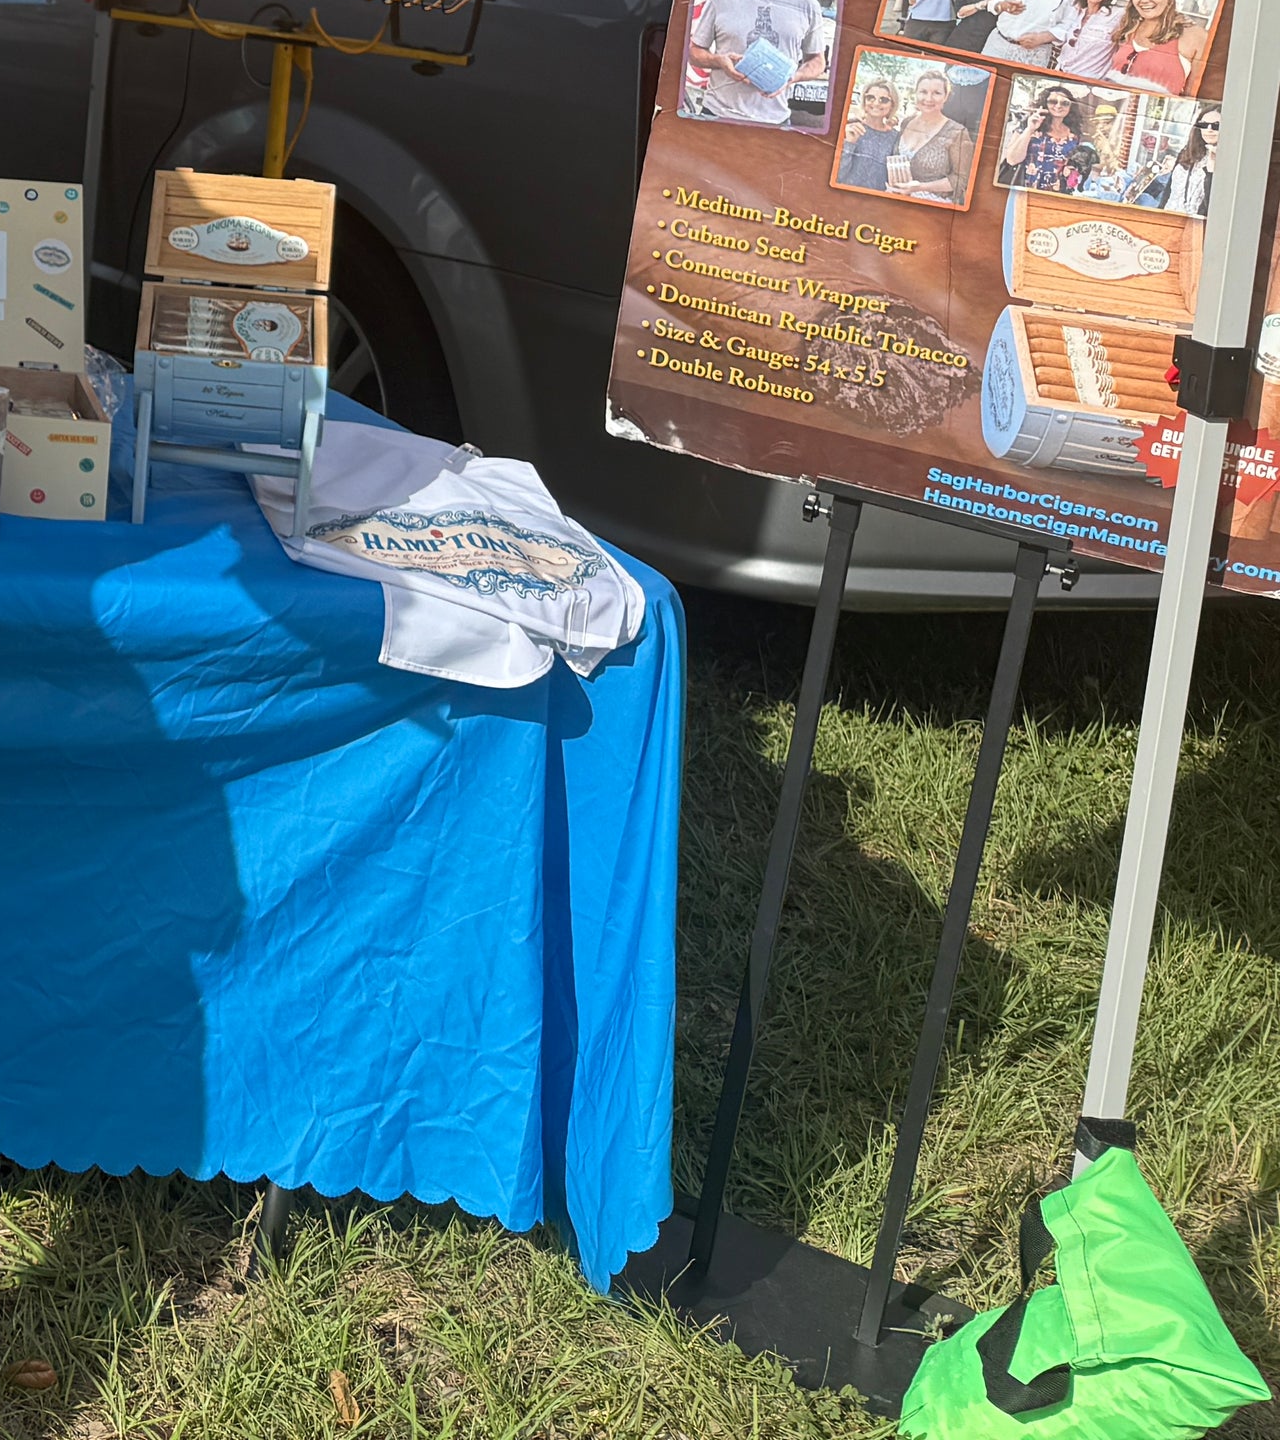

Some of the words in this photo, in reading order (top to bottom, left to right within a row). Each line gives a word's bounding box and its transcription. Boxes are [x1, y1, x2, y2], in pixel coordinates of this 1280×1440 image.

[206, 218, 242, 234] ENIGMA
[670, 218, 751, 252] Cubano
[754, 236, 807, 264] Seed
[674, 186, 850, 240] Medium-Bodied
[854, 223, 918, 254] Cigar
[1065, 223, 1104, 238] ENIGMA
[664, 249, 791, 294] Connecticut
[795, 276, 890, 314] Wrapper
[653, 318, 696, 344] Size
[699, 329, 723, 351] &
[726, 335, 801, 370] Gauge:
[803, 354, 832, 376] 54
[834, 365, 849, 380] x
[851, 364, 887, 388] 5.5
[658, 282, 772, 327] Dominican
[776, 310, 873, 349] Republic
[876, 329, 968, 369] Tobacco
[648, 346, 723, 383] Double
[727, 366, 815, 404] Robusto
[927, 466, 1159, 533] SagHarborCigars.com
[360, 531, 531, 561] HAMPTONS
